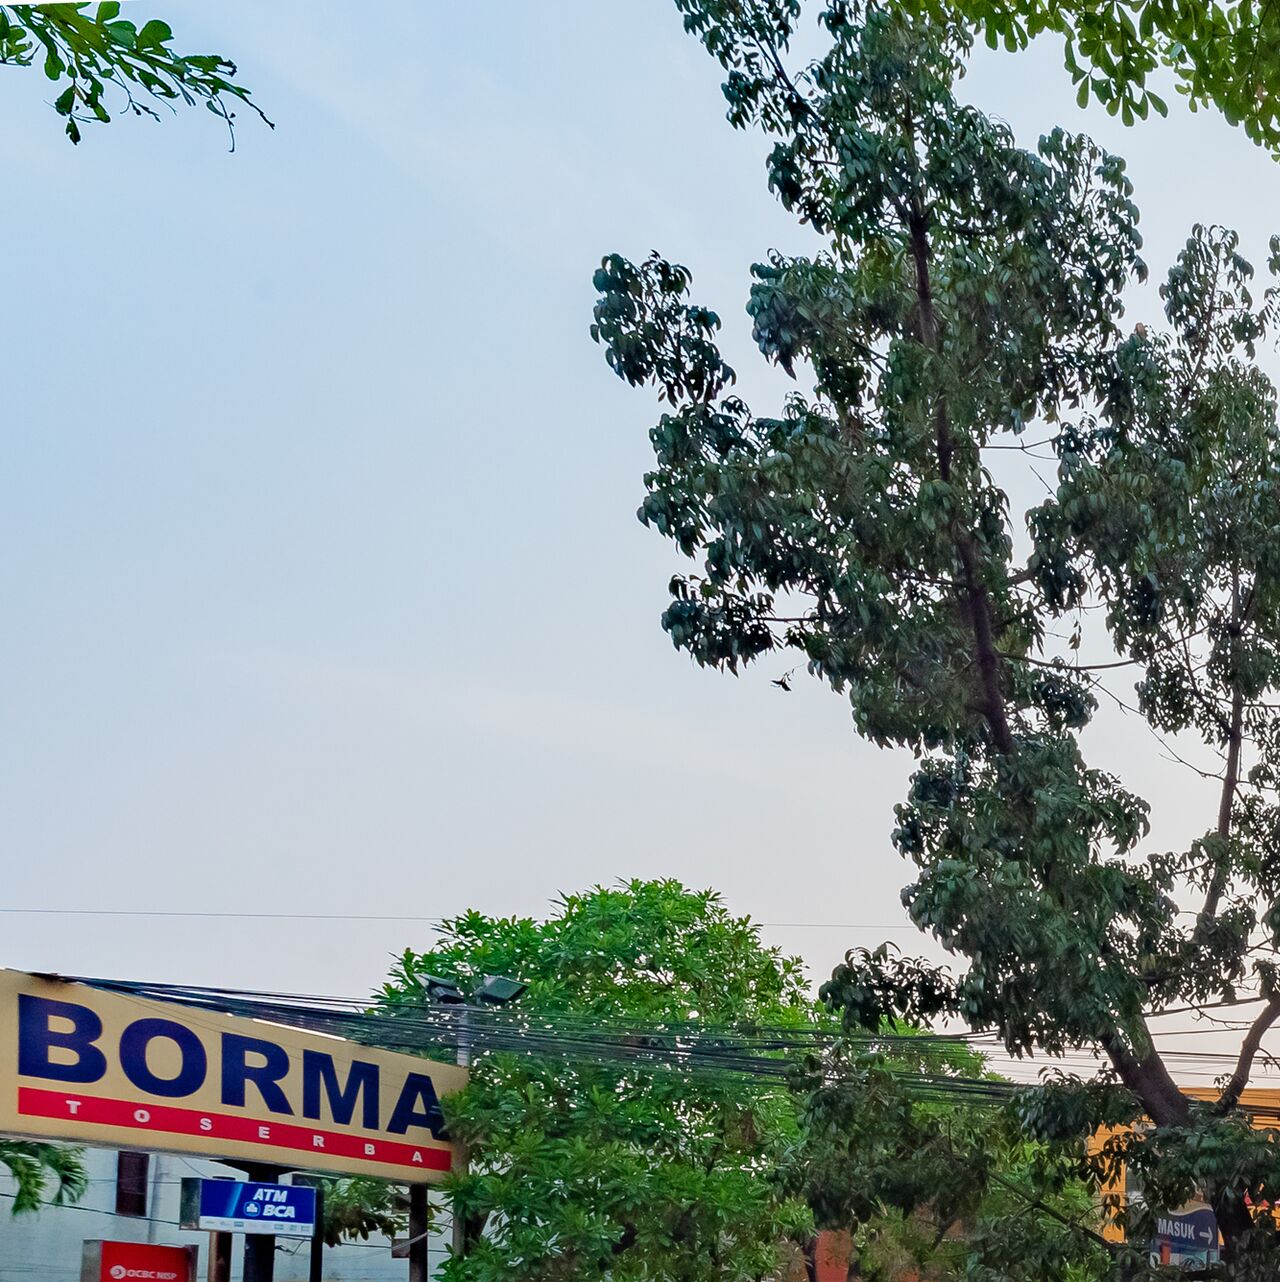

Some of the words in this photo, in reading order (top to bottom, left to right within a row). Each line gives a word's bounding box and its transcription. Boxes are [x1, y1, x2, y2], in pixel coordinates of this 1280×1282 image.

[18, 993, 449, 1141] BORMA
[66, 1100, 423, 1163] TOSERBA
[253, 1188, 288, 1203] ATM
[262, 1204, 296, 1218] BCA
[1158, 1218, 1195, 1240] MASUK
[127, 1269, 156, 1279] OCBC
